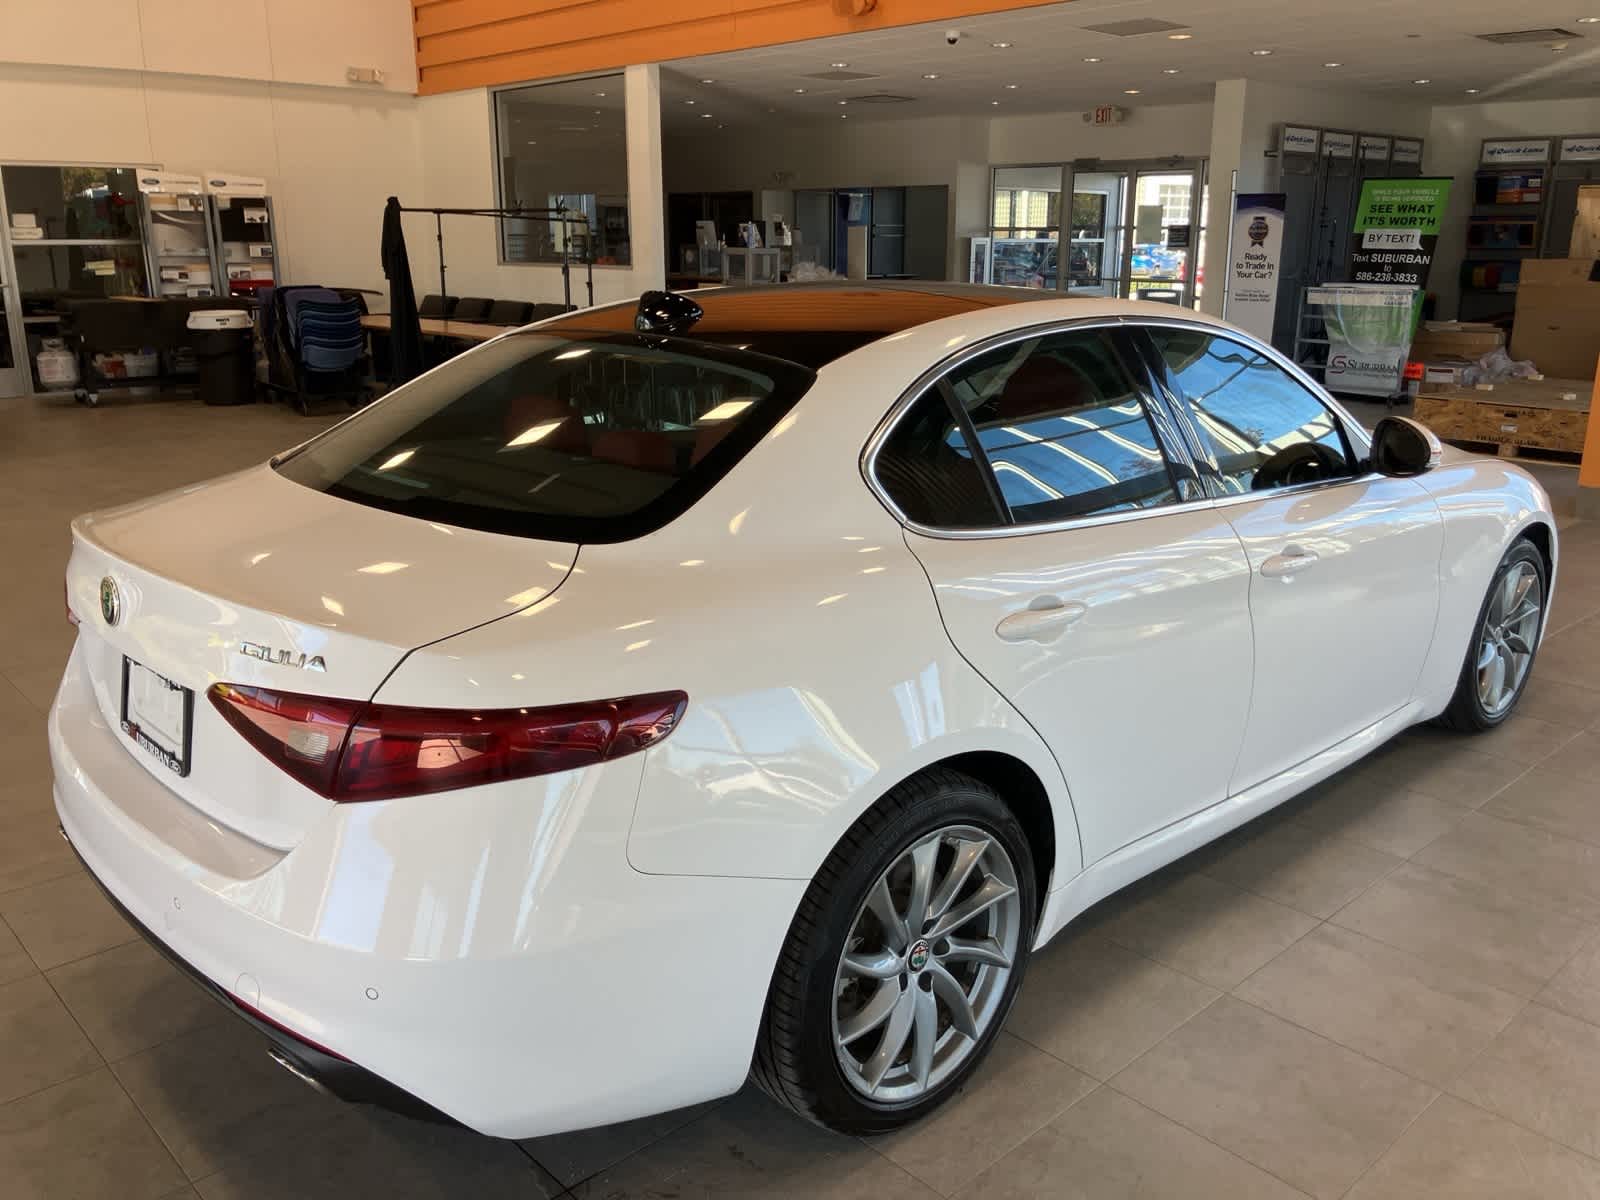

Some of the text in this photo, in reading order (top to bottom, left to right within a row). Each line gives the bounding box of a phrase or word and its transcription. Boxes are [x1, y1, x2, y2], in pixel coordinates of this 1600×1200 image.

[1096, 107, 1112, 123] EXIT
[1369, 204, 1435, 214] SEE WHAT
[1363, 216, 1436, 226] IT'S WORTH
[1368, 233, 1415, 243] BY TEXT!
[1245, 253, 1267, 262] Ready
[1352, 253, 1430, 264] Text SUBURBAN
[1236, 262, 1243, 270] to
[1245, 262, 1266, 270] Trade
[1384, 264, 1392, 272] to
[1236, 270, 1272, 279] Your Car?
[239, 641, 328, 673] GIULIA
